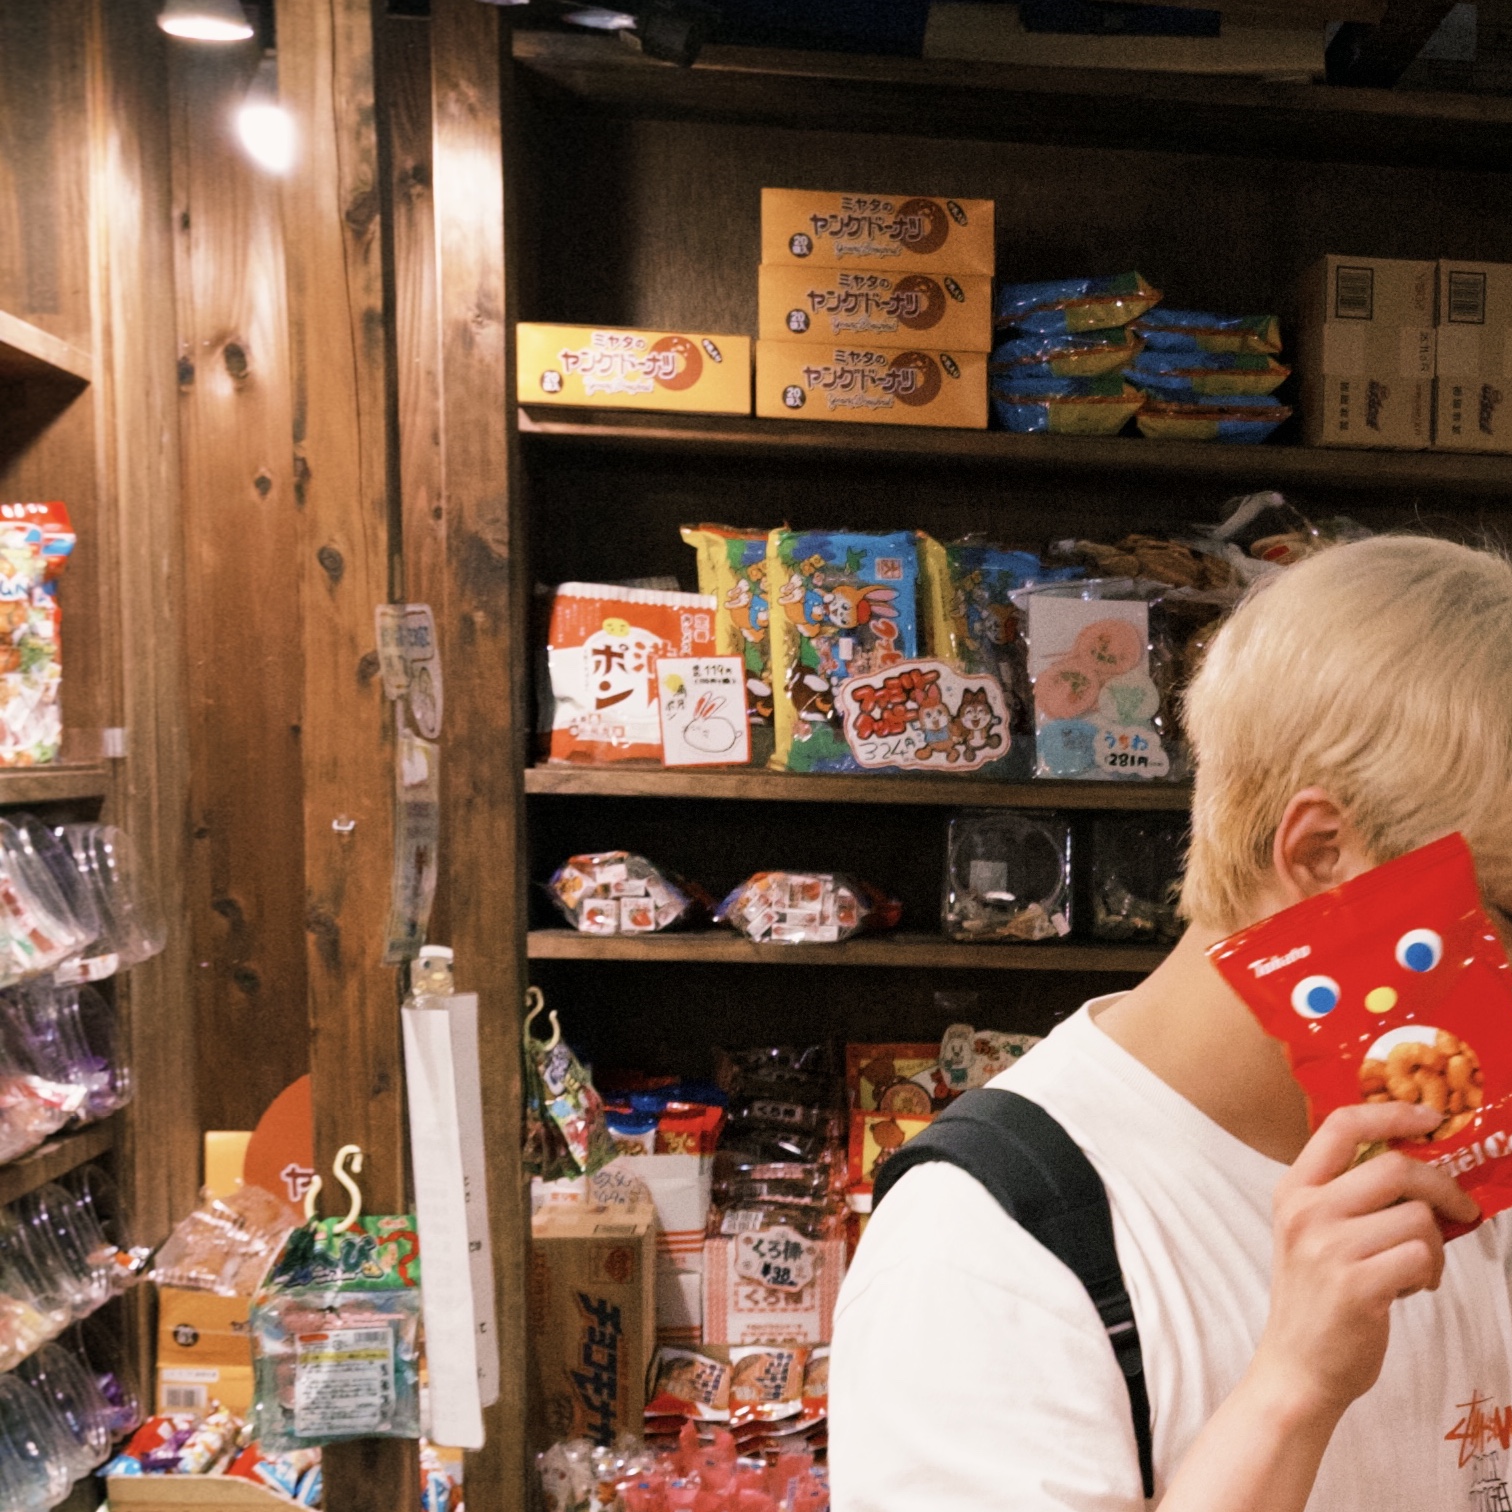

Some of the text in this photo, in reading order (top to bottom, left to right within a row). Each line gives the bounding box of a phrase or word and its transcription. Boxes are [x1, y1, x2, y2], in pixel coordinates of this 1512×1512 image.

[810, 213, 925, 242] ヤングドーナツ
[807, 289, 921, 319] ヤングドーナツ
[560, 350, 678, 380] ヤングドーナツ
[803, 366, 917, 395] ヤングドーナツ
[1104, 730, 1149, 751] うちわ
[1108, 753, 1149, 768] 281円
[1247, 943, 1313, 980] Tohato
[752, 1238, 804, 1262] くろ棒
